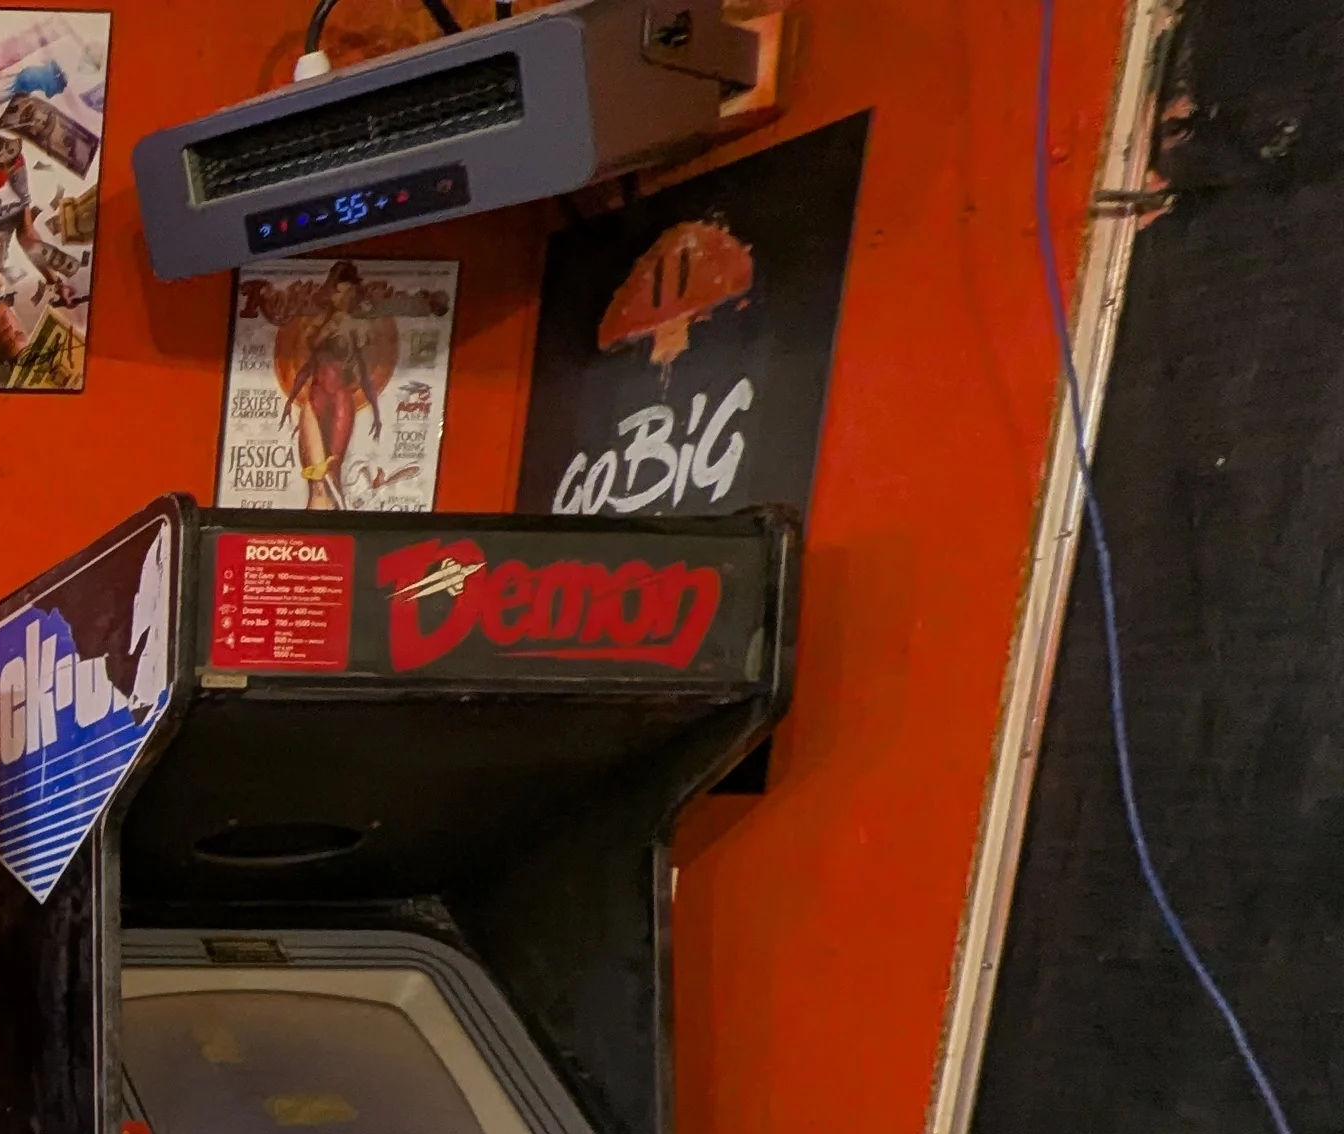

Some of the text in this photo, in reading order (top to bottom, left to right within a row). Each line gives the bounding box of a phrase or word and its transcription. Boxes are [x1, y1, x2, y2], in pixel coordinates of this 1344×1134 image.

[233, 396, 282, 411] SEXIEST
[396, 430, 427, 442] TOON
[229, 445, 296, 473] JESSICA
[233, 467, 292, 490] RABBIT
[377, 538, 721, 672] Demon
